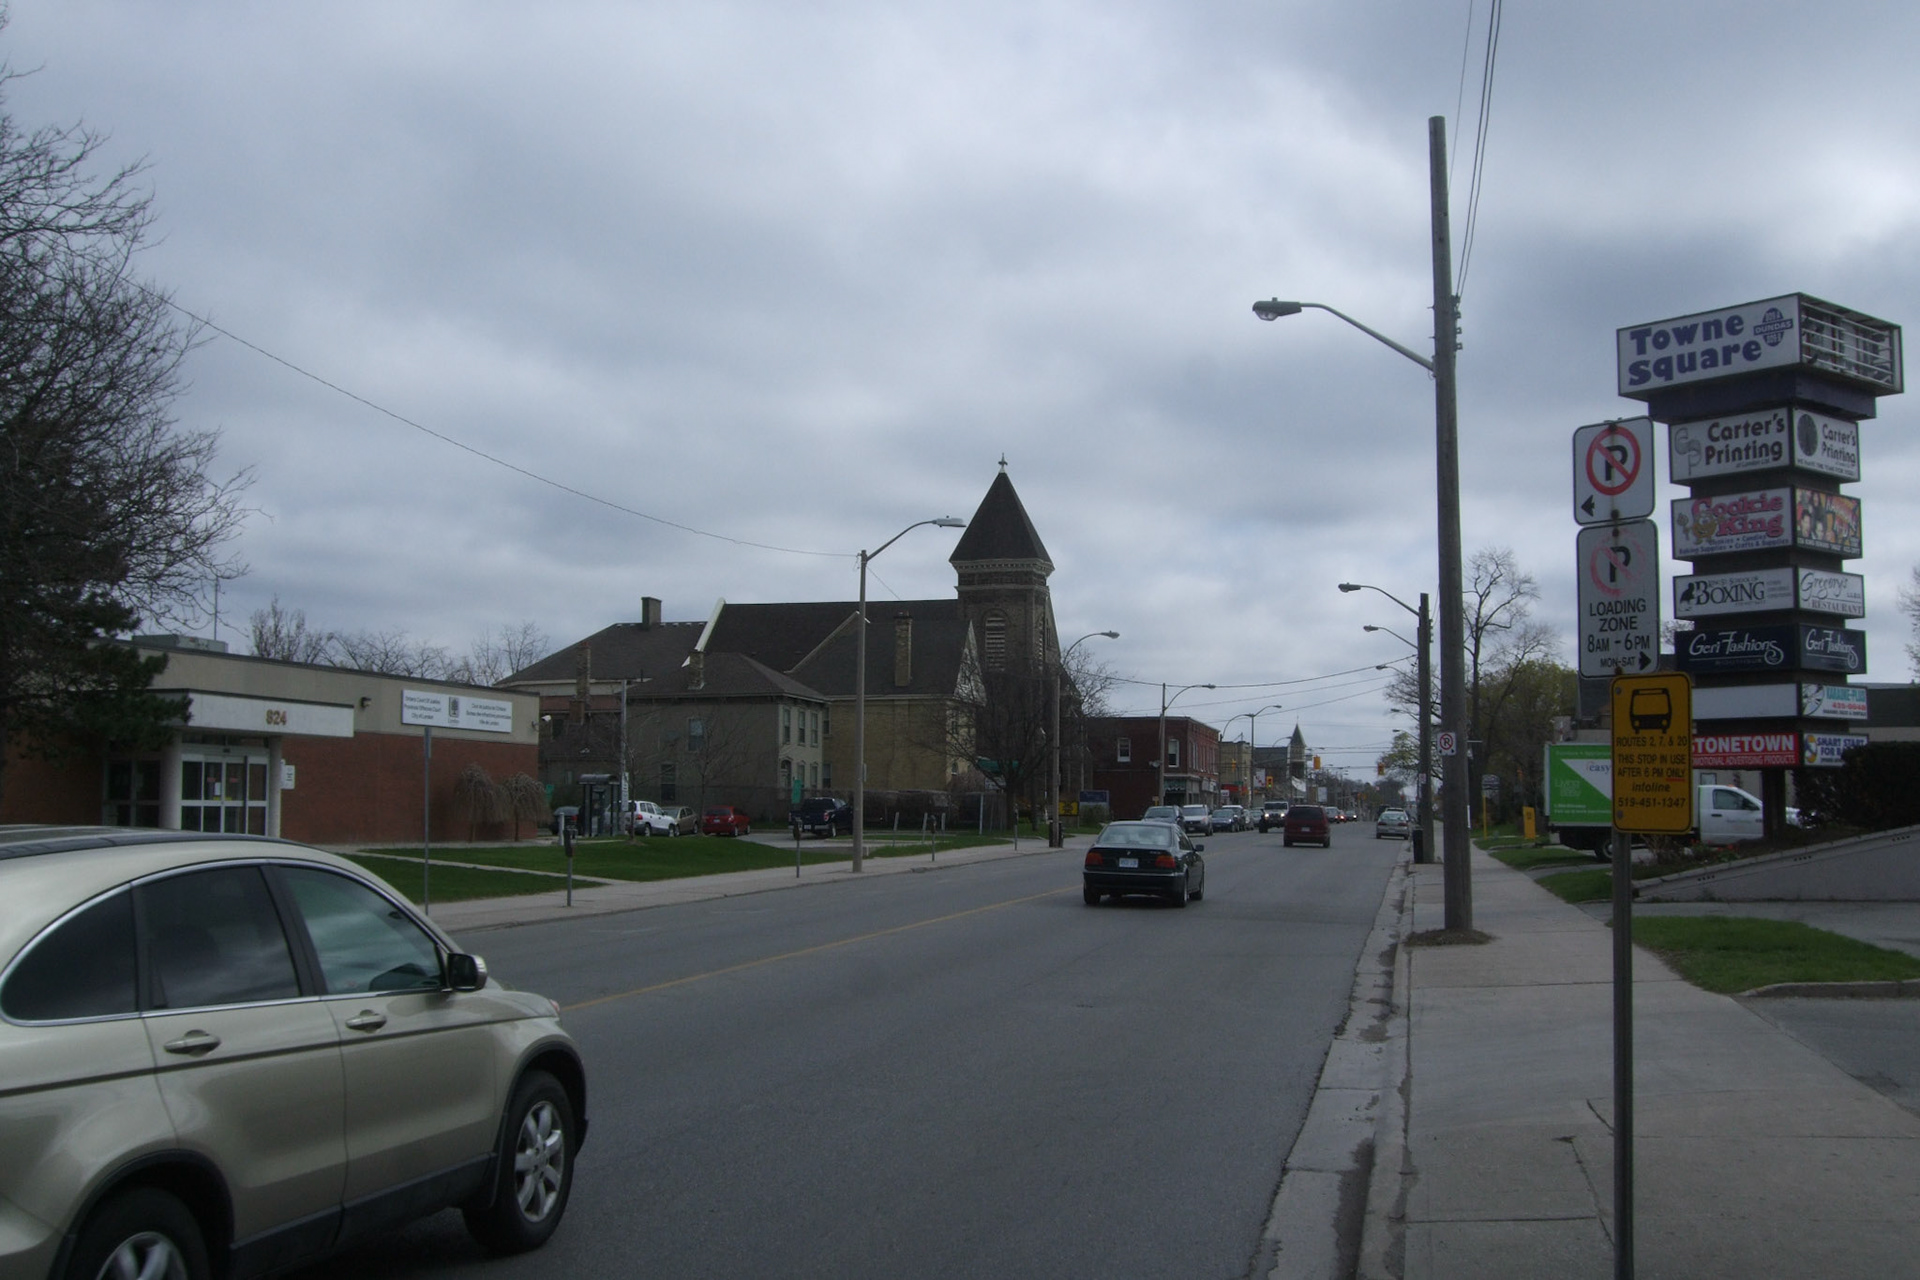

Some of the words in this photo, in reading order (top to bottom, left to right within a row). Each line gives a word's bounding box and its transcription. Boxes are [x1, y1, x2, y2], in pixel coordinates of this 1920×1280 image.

[1630, 315, 1744, 356] Towne
[1755, 320, 1792, 334] DUNDAS
[1628, 340, 1762, 386] Square
[1707, 412, 1785, 442] Carter's
[1822, 424, 1856, 446] Carter's
[1704, 440, 1783, 466] Printing
[1822, 442, 1856, 467] Printing
[1692, 493, 1783, 518] Cookie
[1716, 514, 1784, 538] King
[1695, 580, 1765, 605] BOXING
[1800, 572, 1848, 602] Gregory's
[1589, 598, 1646, 617] LOADING
[1811, 601, 1861, 615] RESTAURANT
[1599, 617, 1637, 633] ZONE
[1587, 634, 1609, 653] 8AM
[1625, 632, 1650, 651] 6PM
[1689, 633, 1720, 655] Geri
[1718, 631, 1784, 665] Fashions
[1805, 628, 1824, 650] Geri
[1823, 630, 1858, 668] Fashions
[1600, 655, 1635, 668] MON-SAT
[266, 709, 287, 725] 824
[1616, 736, 1646, 747] ROUTES
[1668, 736, 1673, 746] &
[1677, 736, 1687, 746] 20
[1817, 737, 1841, 746] SMART
[1618, 754, 1634, 764] THIS
[1638, 754, 1656, 764] STOP
[1660, 754, 1667, 764] IN
[1670, 754, 1686, 764] USE
[1726, 755, 1763, 765] ADVERTISING
[1764, 754, 1795, 764] PRODUCTS
[1821, 746, 1835, 756] FOR
[1590, 765, 1609, 775] easy
[1618, 768, 1640, 778] AFTER
[1644, 768, 1649, 777] 6
[1652, 767, 1663, 777] PM
[1666, 767, 1685, 777] ONLY
[1632, 783, 1670, 792] infoline
[1618, 797, 1686, 808] 519-451-1347
